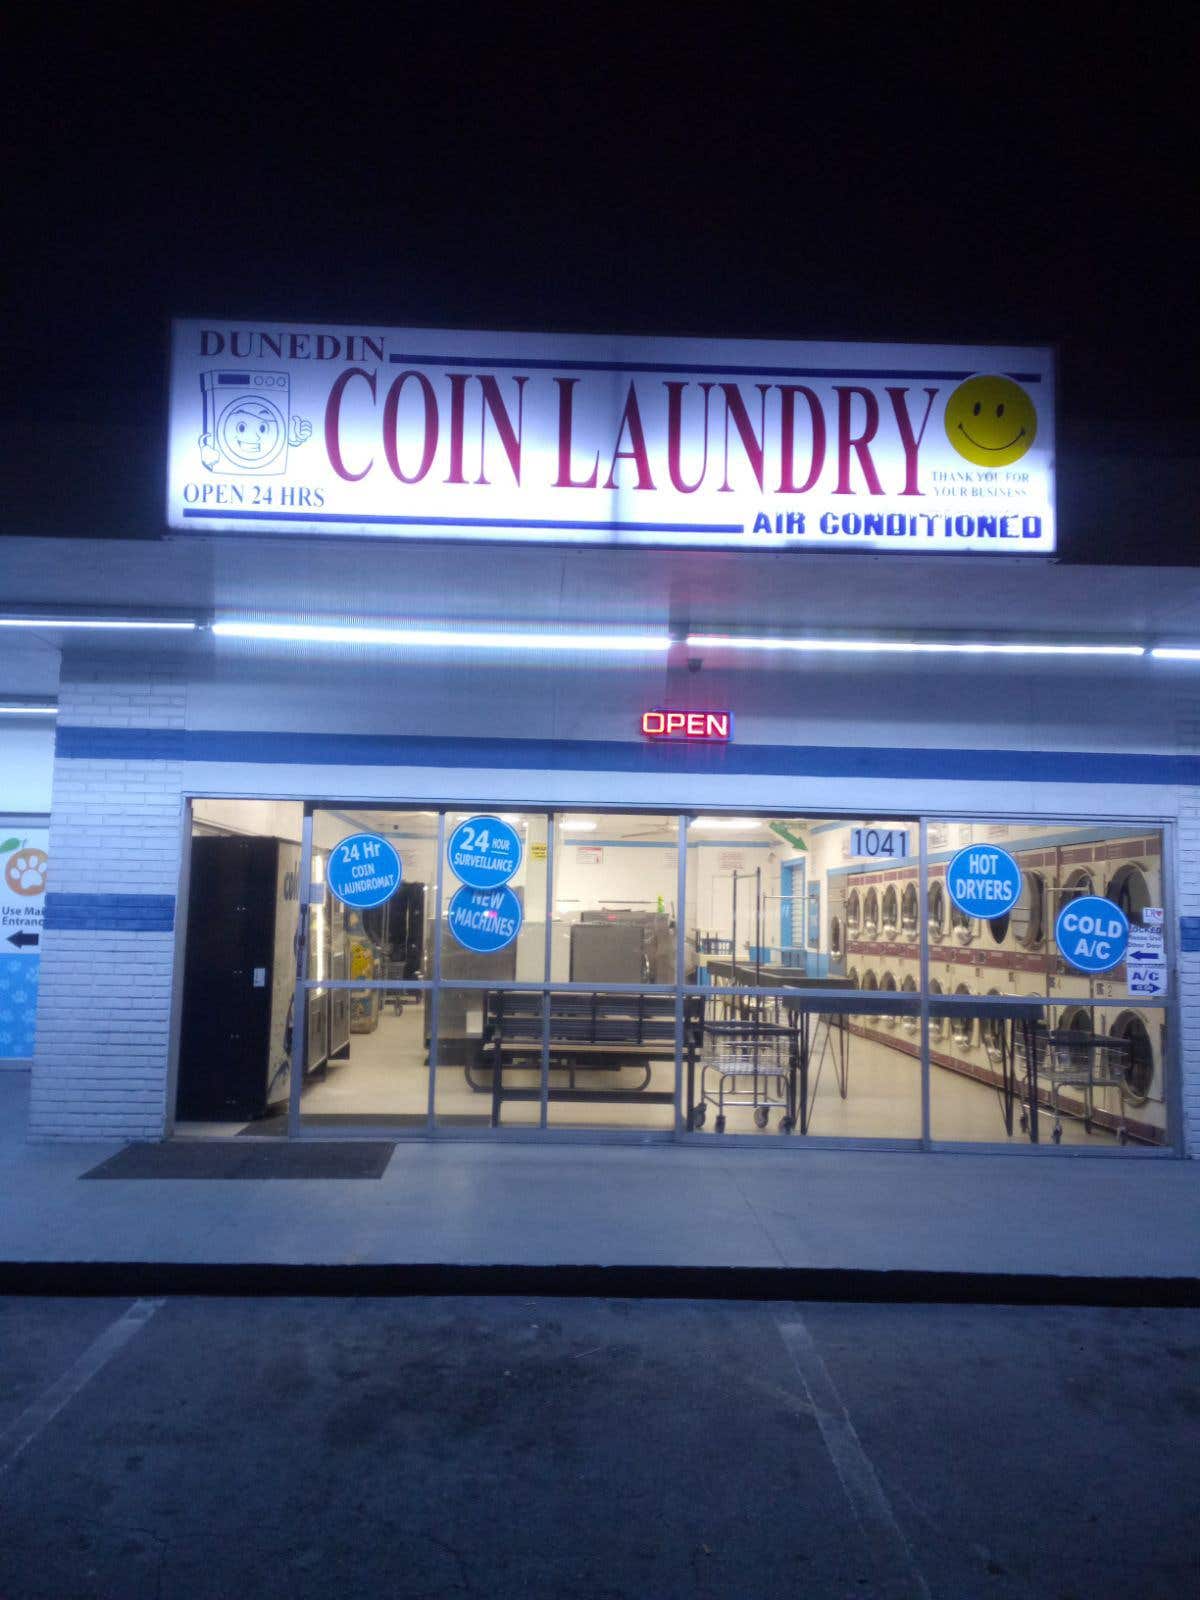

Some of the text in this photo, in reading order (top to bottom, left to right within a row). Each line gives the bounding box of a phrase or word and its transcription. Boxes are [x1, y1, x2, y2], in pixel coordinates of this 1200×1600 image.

[199, 330, 386, 363] DUNEDIN
[324, 367, 940, 497] COIN LAUNDRY
[932, 471, 1029, 482] THANK YOU FOR
[183, 483, 325, 508] OPEN 24 HRS
[934, 486, 1027, 497] YOUR BUSINESS
[752, 511, 1042, 539] AIR CONDITIONED
[642, 711, 728, 736] OPEN
[459, 826, 511, 853] 24 HOUR
[854, 829, 907, 857] 1041
[340, 840, 381, 863] 24 Hr
[454, 852, 514, 873] SURVEILLANCE
[351, 863, 375, 879] COIN
[969, 853, 999, 876] HOT
[338, 874, 395, 896] LAUNDROMAT
[956, 878, 1013, 901] DRYERS
[2, 906, 22, 916] Use
[454, 906, 515, 938] MACHINES
[1062, 913, 1123, 938] COLD
[1074, 938, 1112, 960] A/C
[1132, 969, 1160, 982] A/C
